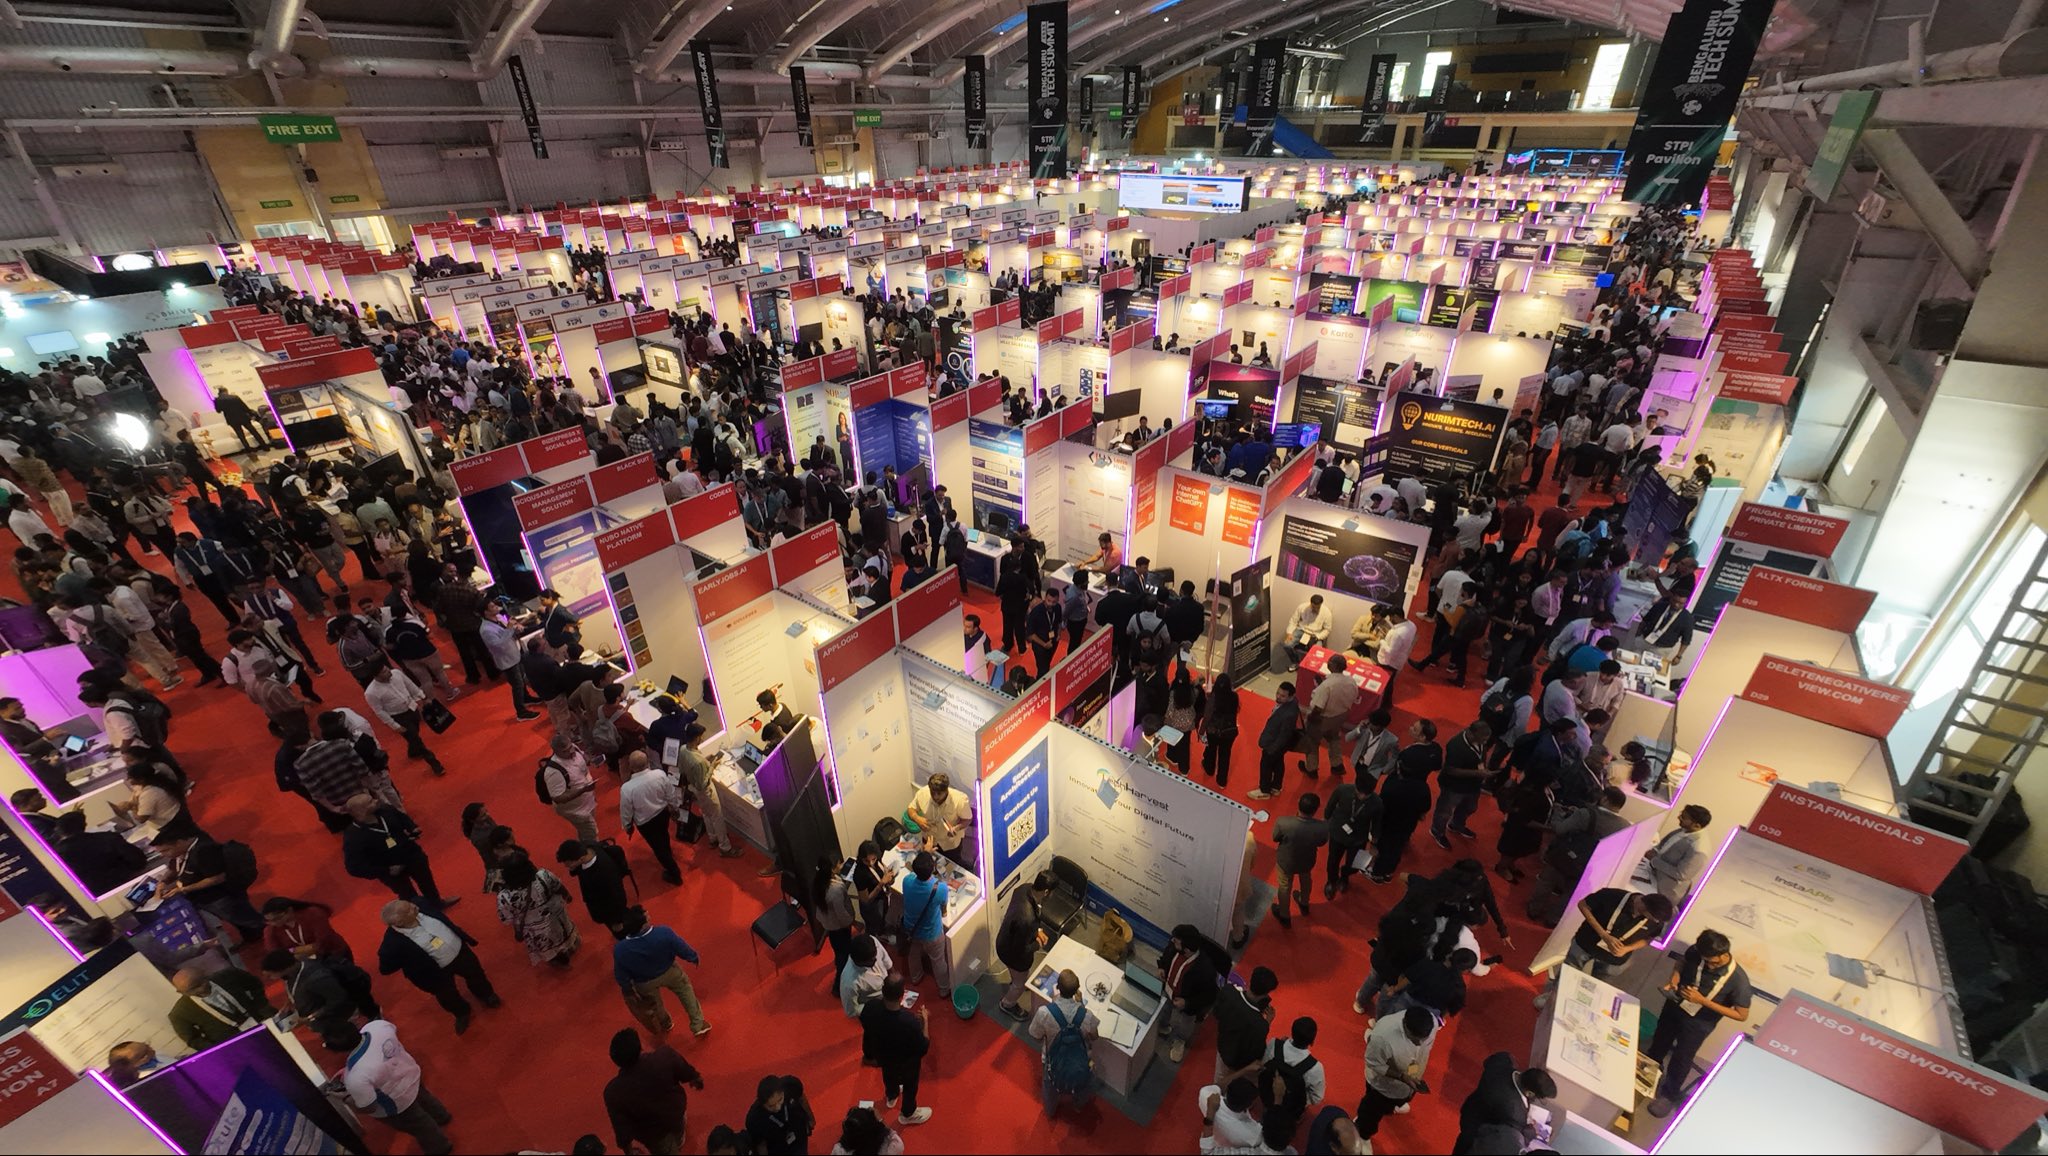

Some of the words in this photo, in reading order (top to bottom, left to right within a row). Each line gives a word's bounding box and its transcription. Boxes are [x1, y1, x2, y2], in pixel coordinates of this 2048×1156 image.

[1047, 21, 1055, 66] SUMMIT
[1687, 10, 1722, 83] BENGALURU
[1699, 40, 1730, 83] TECH
[1047, 67, 1055, 97] TECH
[1264, 58, 1276, 107] MAKERS
[856, 115, 868, 123] FIRE
[869, 115, 881, 123] EXIT
[267, 125, 300, 136] FIRE
[303, 124, 334, 136] EXIT
[1035, 144, 1061, 153] Pavilion
[1664, 141, 1694, 151] STPI
[1646, 154, 1701, 165] Pavilion
[529, 308, 544, 317] STPI
[566, 317, 582, 327] STPI
[1217, 389, 1239, 399] What's
[1423, 412, 1496, 432] NURIMTECH.AI
[544, 441, 566, 452] SOCIAL
[566, 436, 582, 445] SAGA
[1423, 440, 1438, 448] CORE
[1438, 444, 1468, 455] VERTICALS
[453, 457, 484, 472] UPSCALE
[616, 460, 637, 472] BLACK
[637, 456, 650, 466] SUIT
[463, 485, 474, 493] A13
[1176, 482, 1192, 492] Your
[1192, 488, 1206, 496] own
[1176, 489, 1200, 501] Internal
[531, 489, 577, 509] MANAGEMENT
[541, 498, 574, 514] SOLUTION
[527, 519, 538, 527] A12
[1745, 505, 1782, 522] FRUGAL
[1783, 511, 1837, 530] SCIENTIFIC
[1748, 515, 1786, 530] PRIVATE
[1787, 522, 1825, 536] LIMITED
[600, 530, 620, 545] NUBO
[620, 522, 644, 538] NATIVE
[606, 532, 643, 551] PLATFORM
[607, 560, 619, 568] A11
[697, 566, 747, 595] EARLYJOBS.AI
[1755, 571, 1782, 585] ALTX
[1783, 577, 1825, 593] FORMS
[705, 610, 717, 621] A10
[1097, 633, 1111, 648] TECH
[1073, 648, 1104, 678] SOLUTIONS
[827, 677, 836, 686] A9
[1065, 670, 1088, 693] PRIVATE
[1088, 652, 1109, 674] LIMITED
[1750, 691, 1770, 702] D29
[1798, 681, 1864, 705] VIEW.COM
[994, 691, 1041, 733] TECHHARVEST
[984, 716, 1022, 753] SOLUTIONS
[985, 760, 995, 772] A8
[1004, 792, 1030, 821] Contact
[1030, 785, 1039, 797] Us
[1134, 808, 1163, 827] Digital
[1165, 822, 1195, 842] Future
[1779, 790, 1926, 846] INSTAFINANCIALS
[1758, 823, 1782, 838] D30
[52, 969, 91, 1003] ELIT
[1768, 1038, 1799, 1057] D31
[1795, 1006, 1856, 1036] ENSO
[1860, 1031, 1999, 1097] WEBWORKS
[37, 1079, 58, 1097] A7
